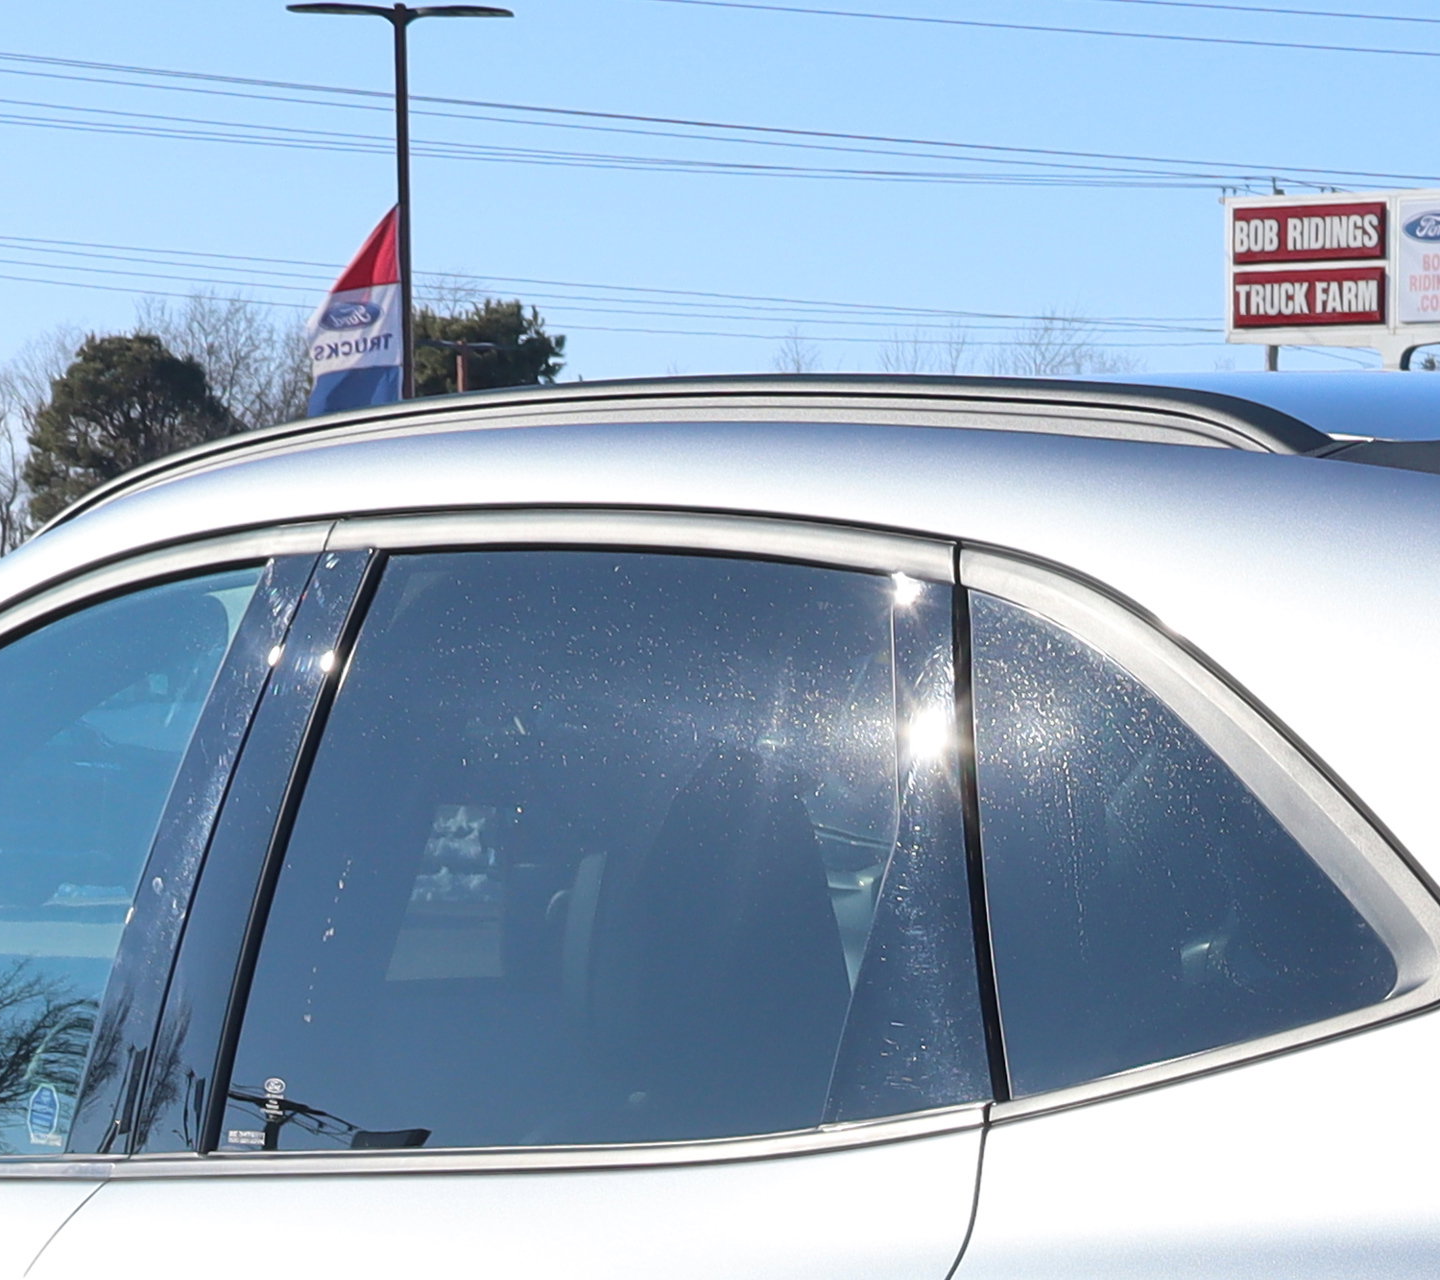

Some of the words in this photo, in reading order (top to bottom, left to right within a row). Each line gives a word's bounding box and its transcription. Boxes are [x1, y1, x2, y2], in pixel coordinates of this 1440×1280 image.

[1235, 219, 1279, 253] BOB
[1287, 214, 1379, 251] RIDINGS
[1235, 282, 1309, 316] TRUCK
[1315, 280, 1378, 314] FARM
